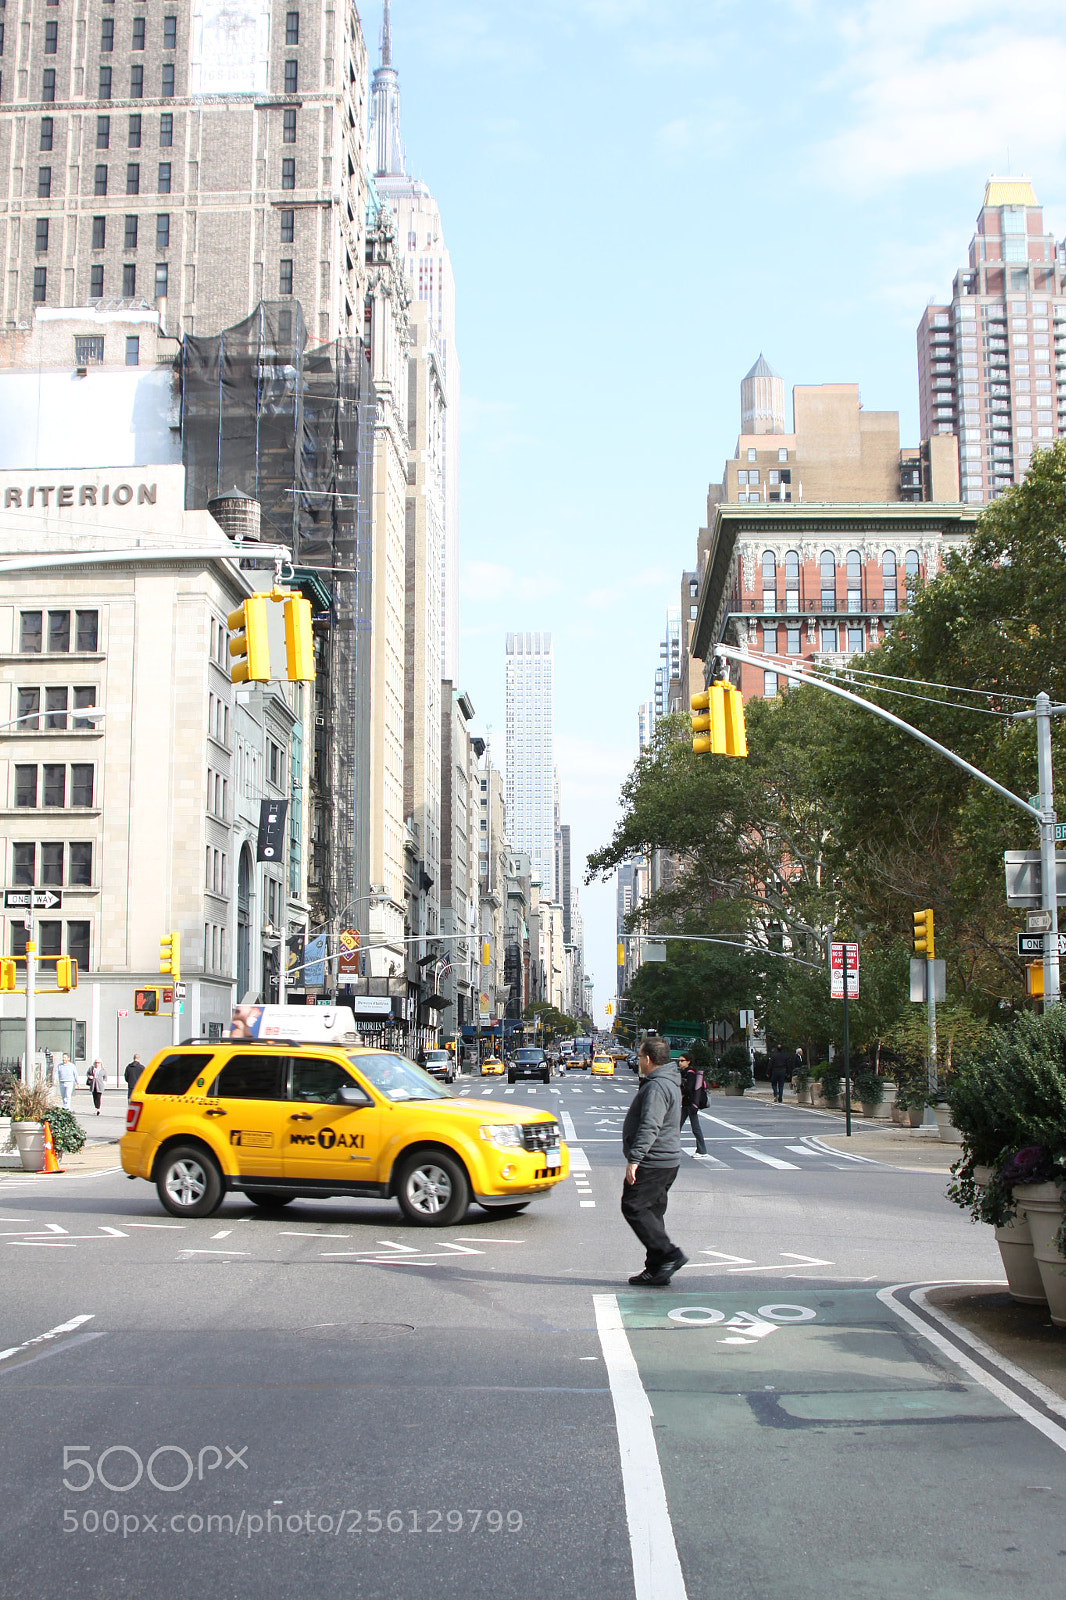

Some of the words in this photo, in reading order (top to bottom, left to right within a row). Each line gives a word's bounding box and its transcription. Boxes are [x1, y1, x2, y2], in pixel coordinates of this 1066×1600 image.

[4, 483, 157, 508] RITERION
[264, 804, 278, 857] HELLO
[12, 896, 29, 904] ONE
[1027, 940, 1043, 949] ONE
[1058, 940, 1066, 949] AY
[290, 1134, 316, 1146] NYC
[318, 1127, 365, 1149] TAXI
